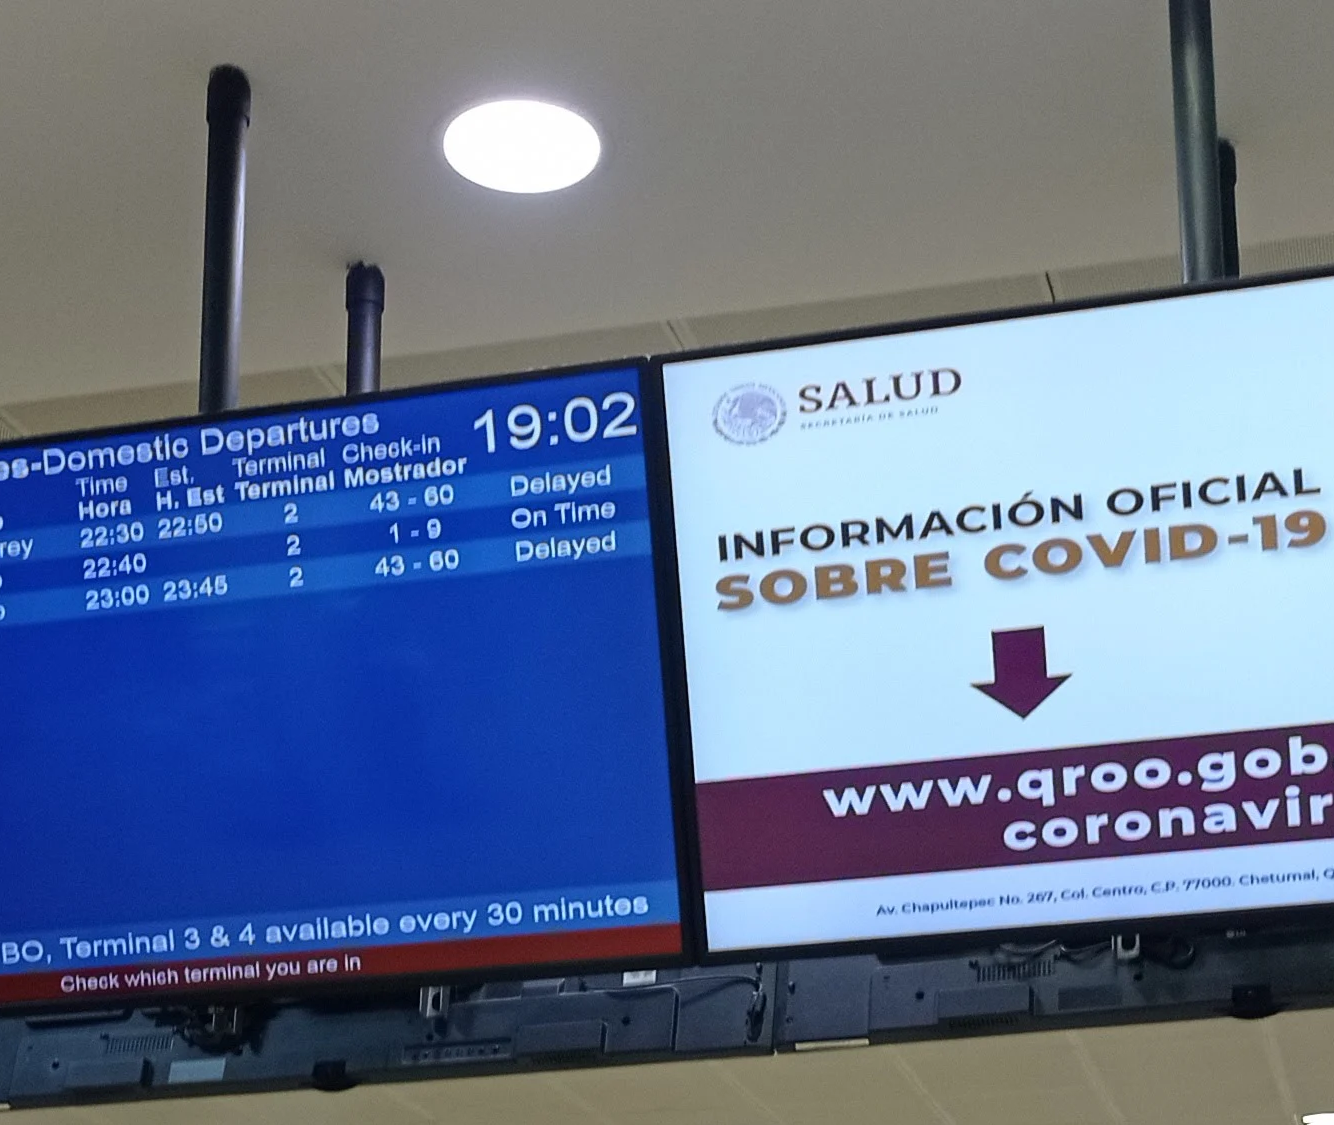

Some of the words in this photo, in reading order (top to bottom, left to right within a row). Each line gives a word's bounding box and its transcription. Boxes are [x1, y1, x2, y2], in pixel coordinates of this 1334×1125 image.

[798, 368, 962, 412] SALUD
[200, 412, 379, 455] Departures
[473, 391, 637, 453] 19:02
[75, 476, 128, 497] Time
[153, 463, 195, 489] Est.
[232, 447, 325, 477] Terminal
[342, 434, 441, 464] Check-in
[78, 499, 132, 520] Hora
[155, 489, 179, 511] H.
[186, 484, 225, 507] Est
[234, 470, 335, 501] Terminal
[343, 456, 467, 488] Mostrador
[80, 521, 144, 548] 22:30
[510, 463, 611, 497] Delayed
[717, 491, 1084, 562] INFORMACIÓN
[1106, 467, 1321, 516] OFICIAL
[82, 552, 147, 579] 22:40
[511, 507, 547, 529] On
[553, 501, 616, 524] Time
[85, 583, 150, 610] 23:00
[515, 529, 616, 562] Delayed
[715, 550, 953, 613] SOBRE
[983, 510, 1327, 582] COVID-19
[59, 928, 175, 959] Terminal
[184, 927, 200, 950] 3
[210, 924, 230, 948] &
[238, 922, 256, 945] 4
[265, 913, 390, 943] available
[399, 909, 477, 933] every
[487, 901, 523, 926] 30
[533, 894, 649, 923] minutes
[60, 972, 119, 992] Check
[124, 968, 179, 987] which
[184, 960, 260, 983] terminal
[265, 960, 301, 981] you
[307, 957, 338, 974] are
[344, 953, 361, 971] in
